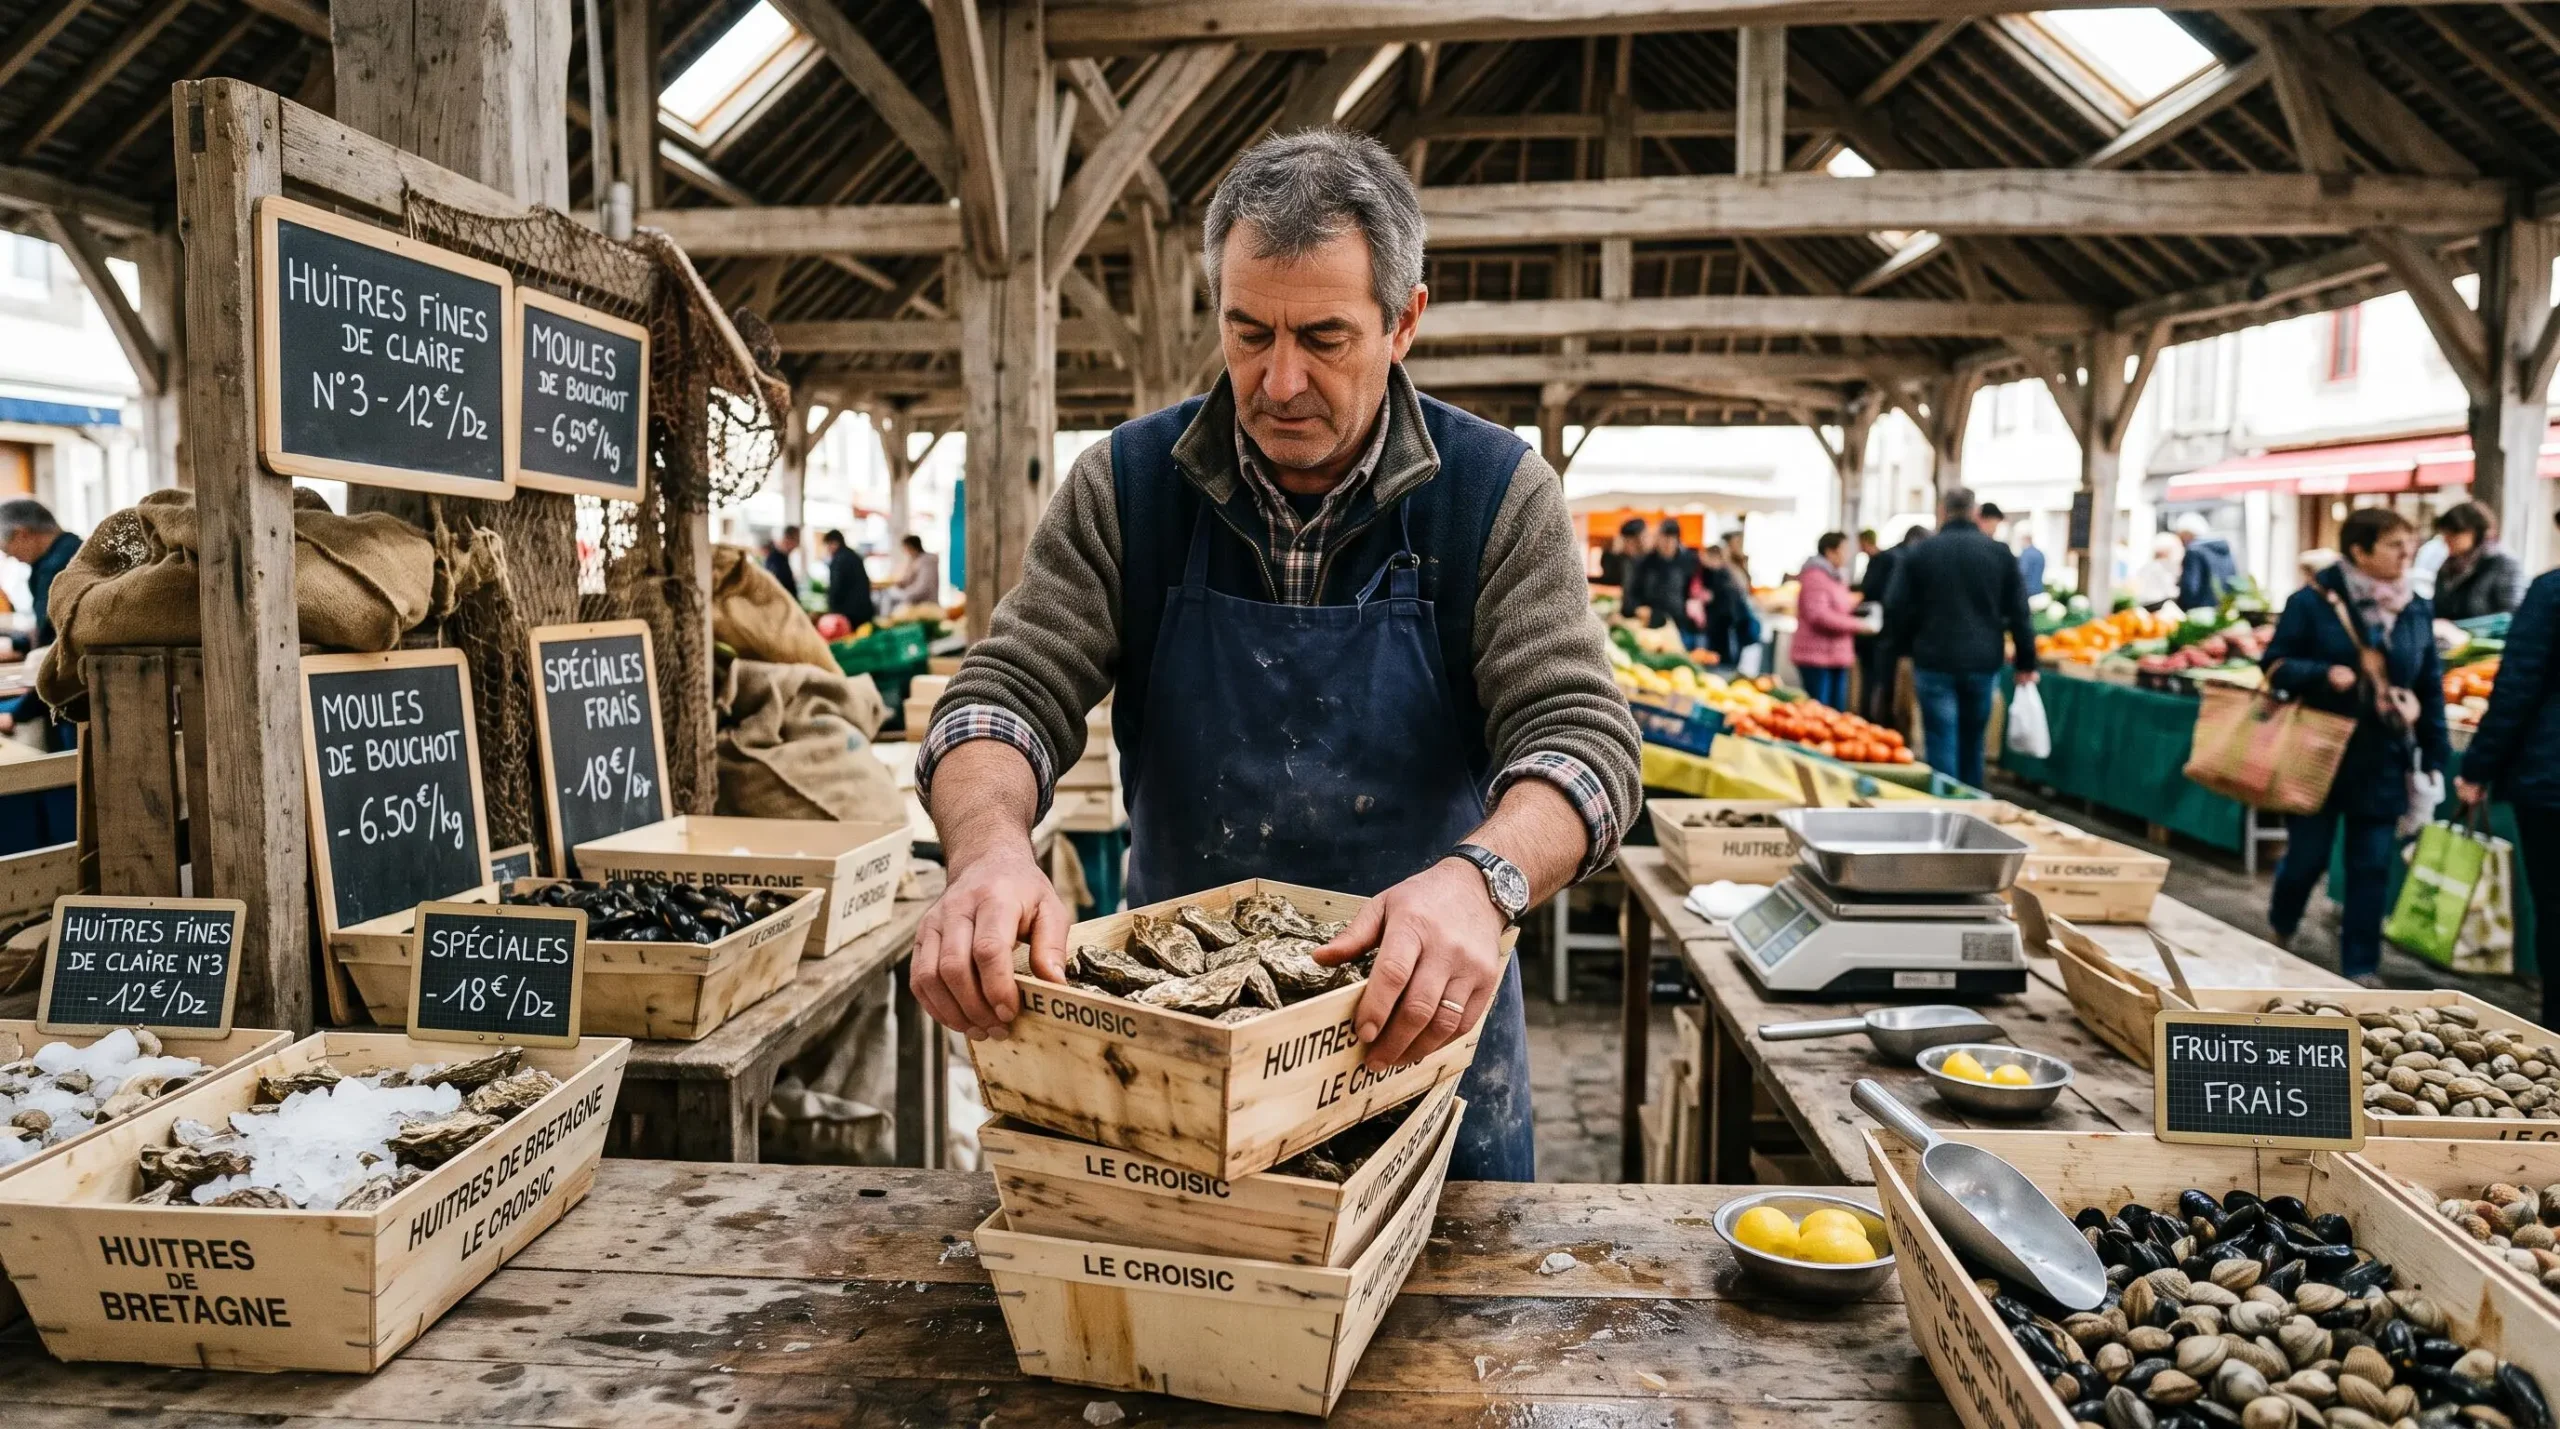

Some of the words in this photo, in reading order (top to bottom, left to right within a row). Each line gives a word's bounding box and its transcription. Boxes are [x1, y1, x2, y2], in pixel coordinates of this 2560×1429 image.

[341, 323, 373, 356] DE
[532, 323, 616, 381] MOULES
[396, 383, 488, 440] 12€/Dz
[538, 370, 559, 396] DE
[565, 376, 629, 413] BOUCHOT
[322, 689, 424, 734] MOULES
[325, 745, 357, 778] DE
[366, 729, 461, 772] BOUCHOT
[359, 782, 464, 850] 6.50€/kg
[1722, 840, 1798, 858] HUITRES
[702, 872, 804, 888] BRETAGNE
[67, 952, 97, 973] DE
[106, 979, 208, 1017] 12€/Dz
[442, 974, 556, 1020] 18€/Dz
[1022, 989, 1046, 1017] LE
[1051, 999, 1137, 1039] CROISIC
[1263, 1017, 1359, 1080] HUITRES
[2266, 1049, 2291, 1065] DE
[2298, 1044, 2346, 1069] MER
[1317, 1071, 1347, 1110] LE
[408, 1165, 494, 1251] HUITRES
[497, 1144, 522, 1188] DE
[524, 1084, 604, 1167] BRETAGNE
[1085, 1156, 1116, 1178] LE
[1123, 1162, 1231, 1199] CROISIC
[461, 1218, 486, 1262] LE
[488, 1166, 556, 1240] CROISIC
[99, 1236, 255, 1272] HUITRES
[1083, 1255, 1115, 1276] LE
[1123, 1259, 1235, 1292] CROISIC
[166, 1272, 198, 1291] DE
[101, 1292, 291, 1328] BRETAGNE
[1889, 1199, 1941, 1302] HUITRES
[1941, 1280, 1964, 1338] DE
[1963, 1311, 2044, 1429] BRETAG
[1933, 1315, 1953, 1367] LE
[1953, 1347, 2006, 1429] CROIS
